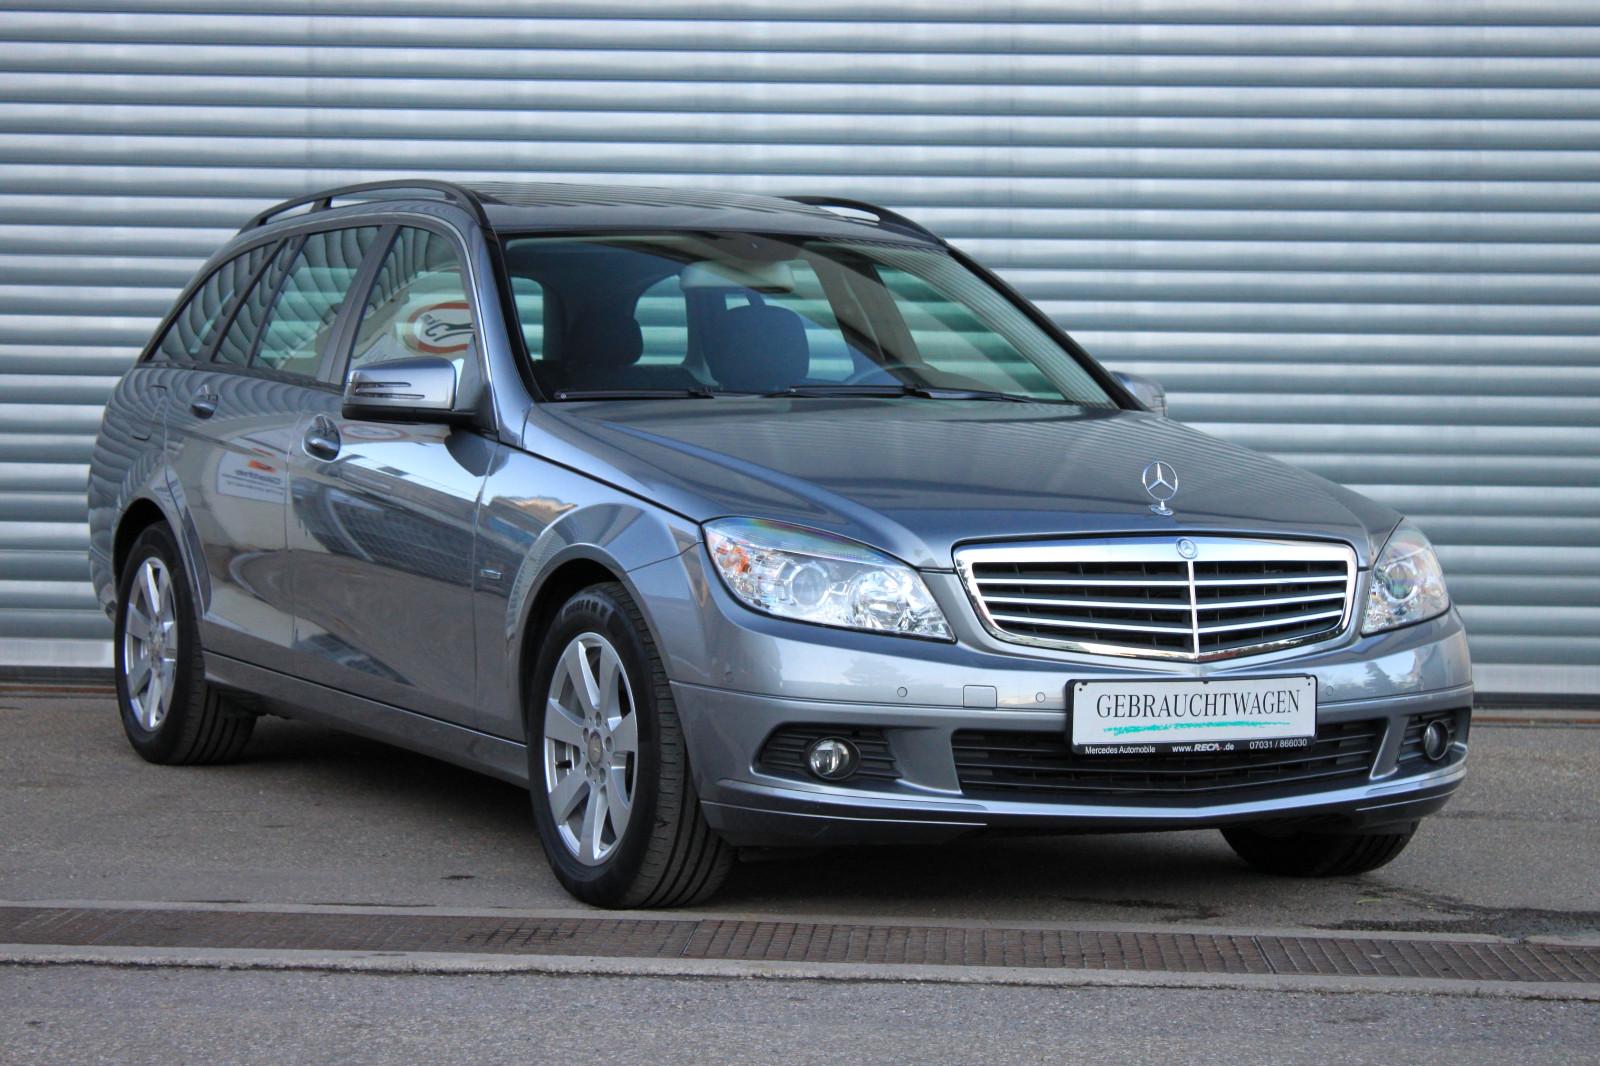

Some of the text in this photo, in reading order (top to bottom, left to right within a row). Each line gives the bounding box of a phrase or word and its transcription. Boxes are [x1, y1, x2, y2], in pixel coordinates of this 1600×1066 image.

[1096, 690, 1300, 718] GEBRAUCHTWAGEN
[1085, 746, 1117, 754] Mercedes
[1119, 745, 1156, 754] Automobile
[1249, 740, 1274, 749] 07031
